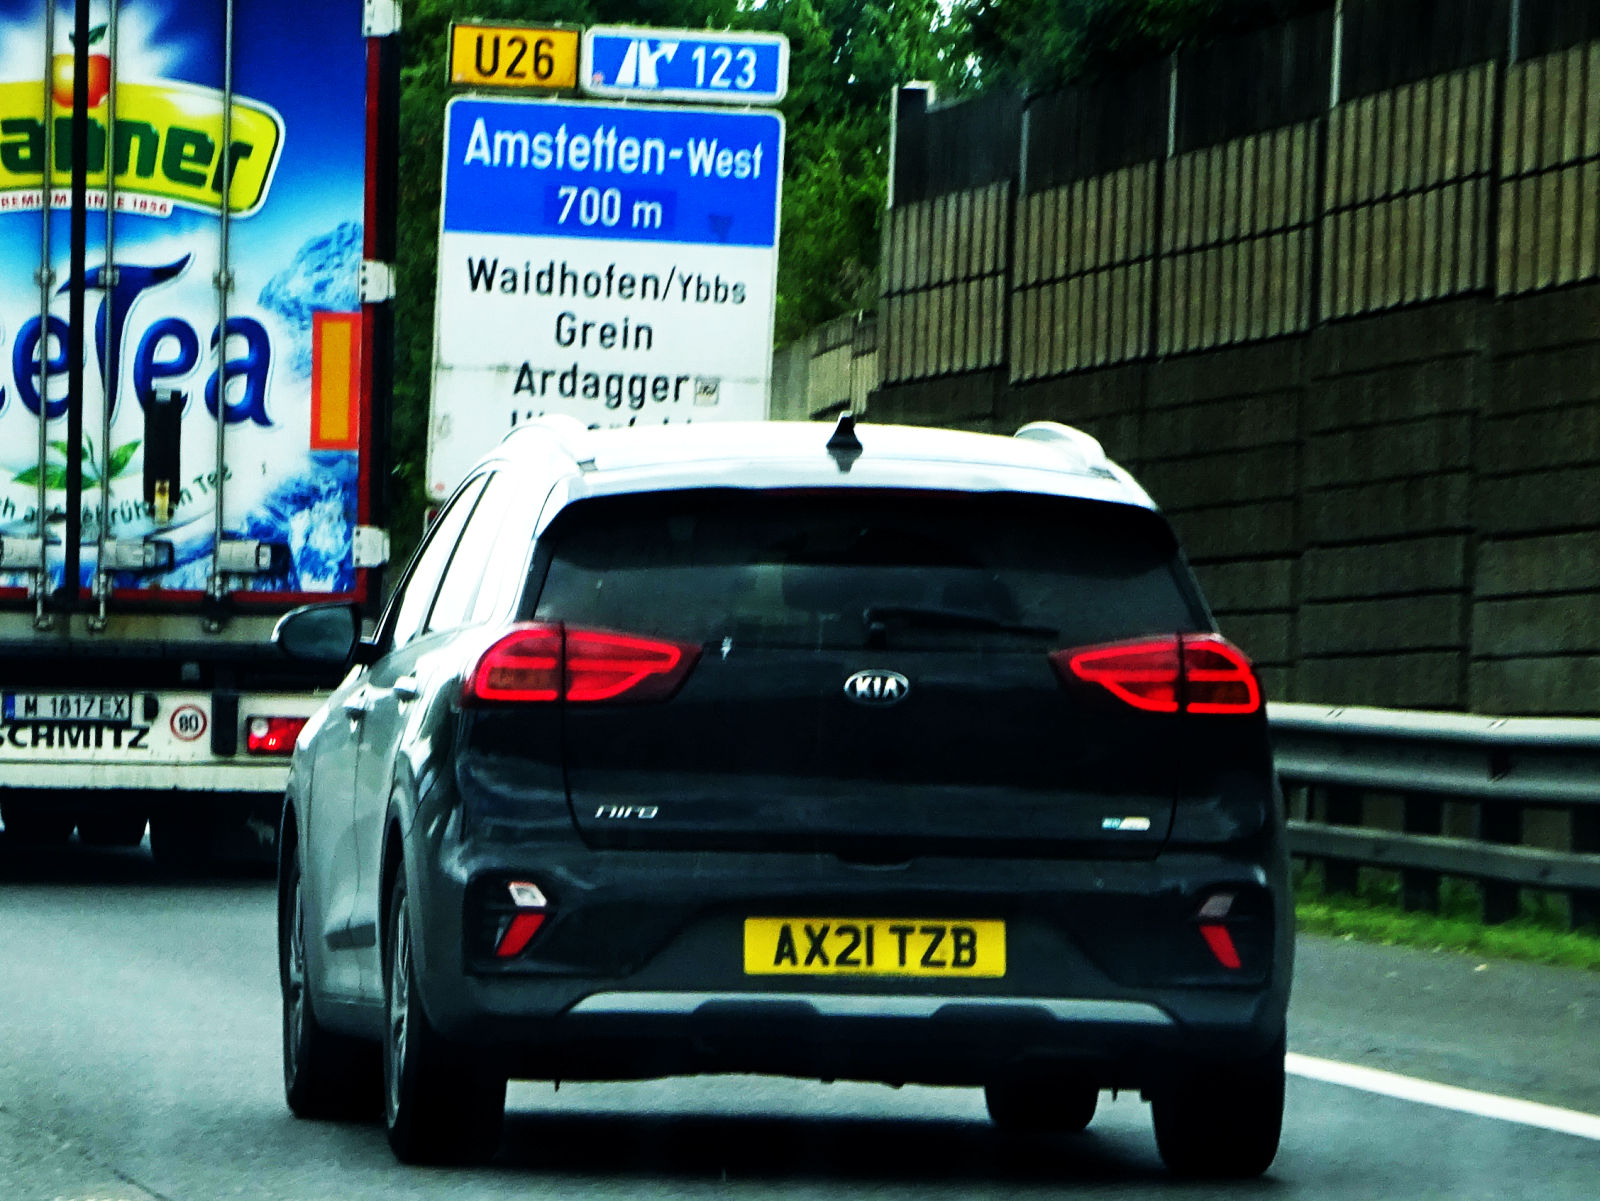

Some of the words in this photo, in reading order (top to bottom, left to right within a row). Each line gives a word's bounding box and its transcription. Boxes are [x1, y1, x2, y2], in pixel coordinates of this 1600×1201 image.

[475, 35, 554, 79] U26
[692, 46, 757, 89] 123
[464, 117, 763, 179] Amstetten-West
[557, 185, 621, 227] 700
[632, 199, 662, 228] m
[468, 256, 747, 305] Waidhofen/Ybbs
[0, 252, 274, 427] eTea
[555, 311, 653, 351] Grein
[513, 360, 691, 411] Ardagger
[856, 676, 900, 698] KIA
[0, 725, 150, 748] CHMITZ
[179, 714, 199, 732] 80
[773, 923, 874, 967] AX21
[889, 925, 977, 968] TZB
